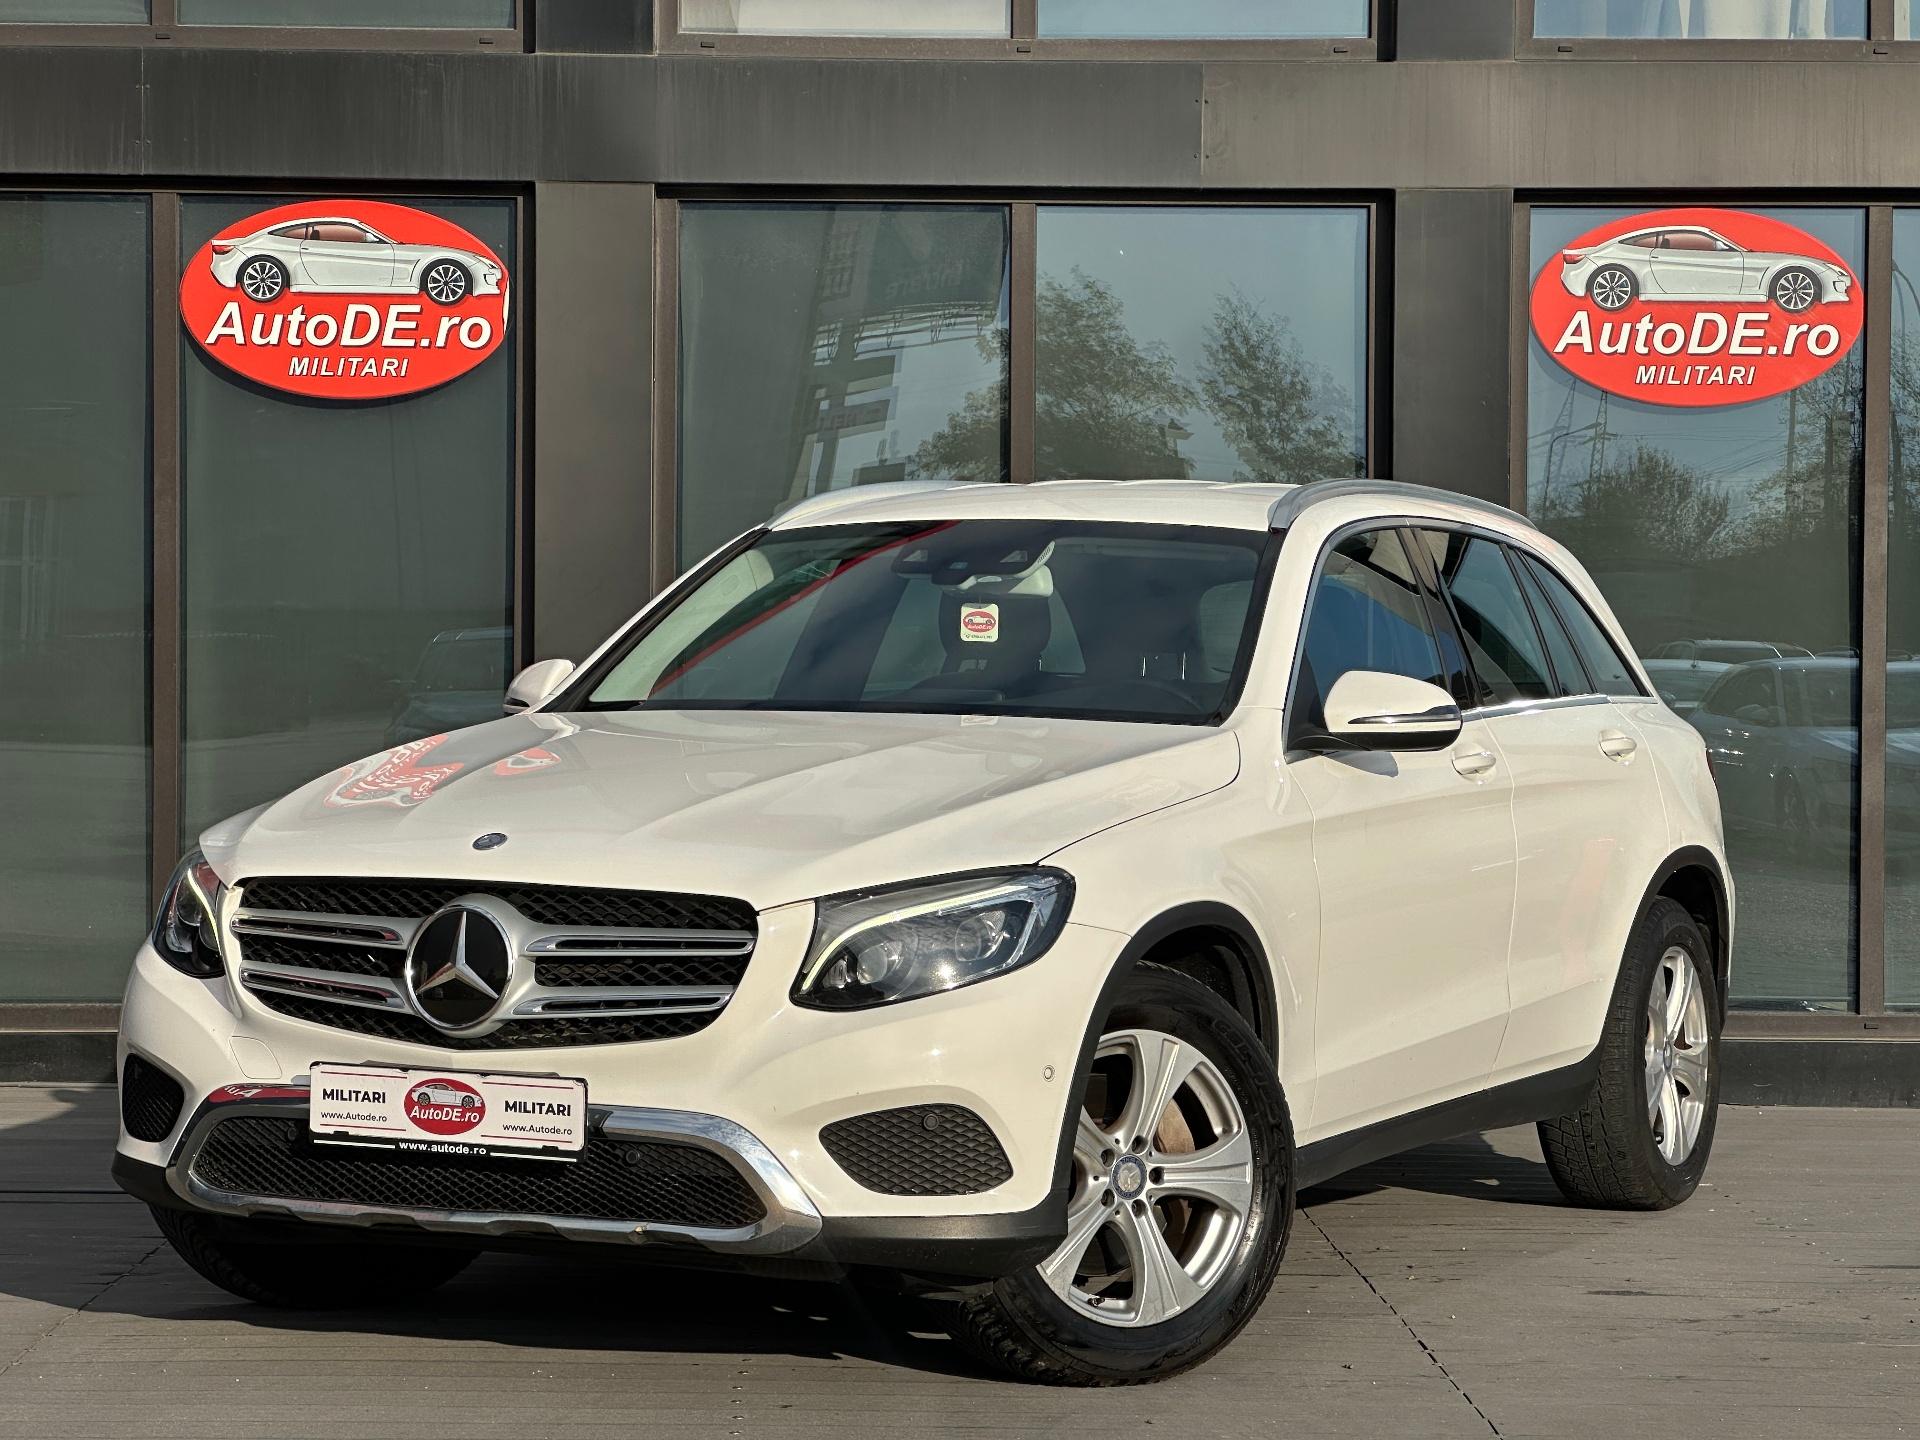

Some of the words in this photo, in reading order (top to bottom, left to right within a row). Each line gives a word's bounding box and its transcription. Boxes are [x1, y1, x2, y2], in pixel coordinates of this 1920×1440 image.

[205, 301, 492, 349] AutoDE.ro
[1553, 310, 1841, 357] AutoDE.ro
[288, 357, 409, 378] MILITARI
[1635, 365, 1755, 386] MILITARI
[322, 1088, 386, 1104] MILITARI
[320, 1111, 388, 1122] www.Autode.ro
[409, 1105, 480, 1123] AutoDE.ro
[504, 1100, 571, 1117] MILITARI
[502, 1123, 573, 1136] www.Autode.ro
[398, 1142, 487, 1155] www.autode.ro
